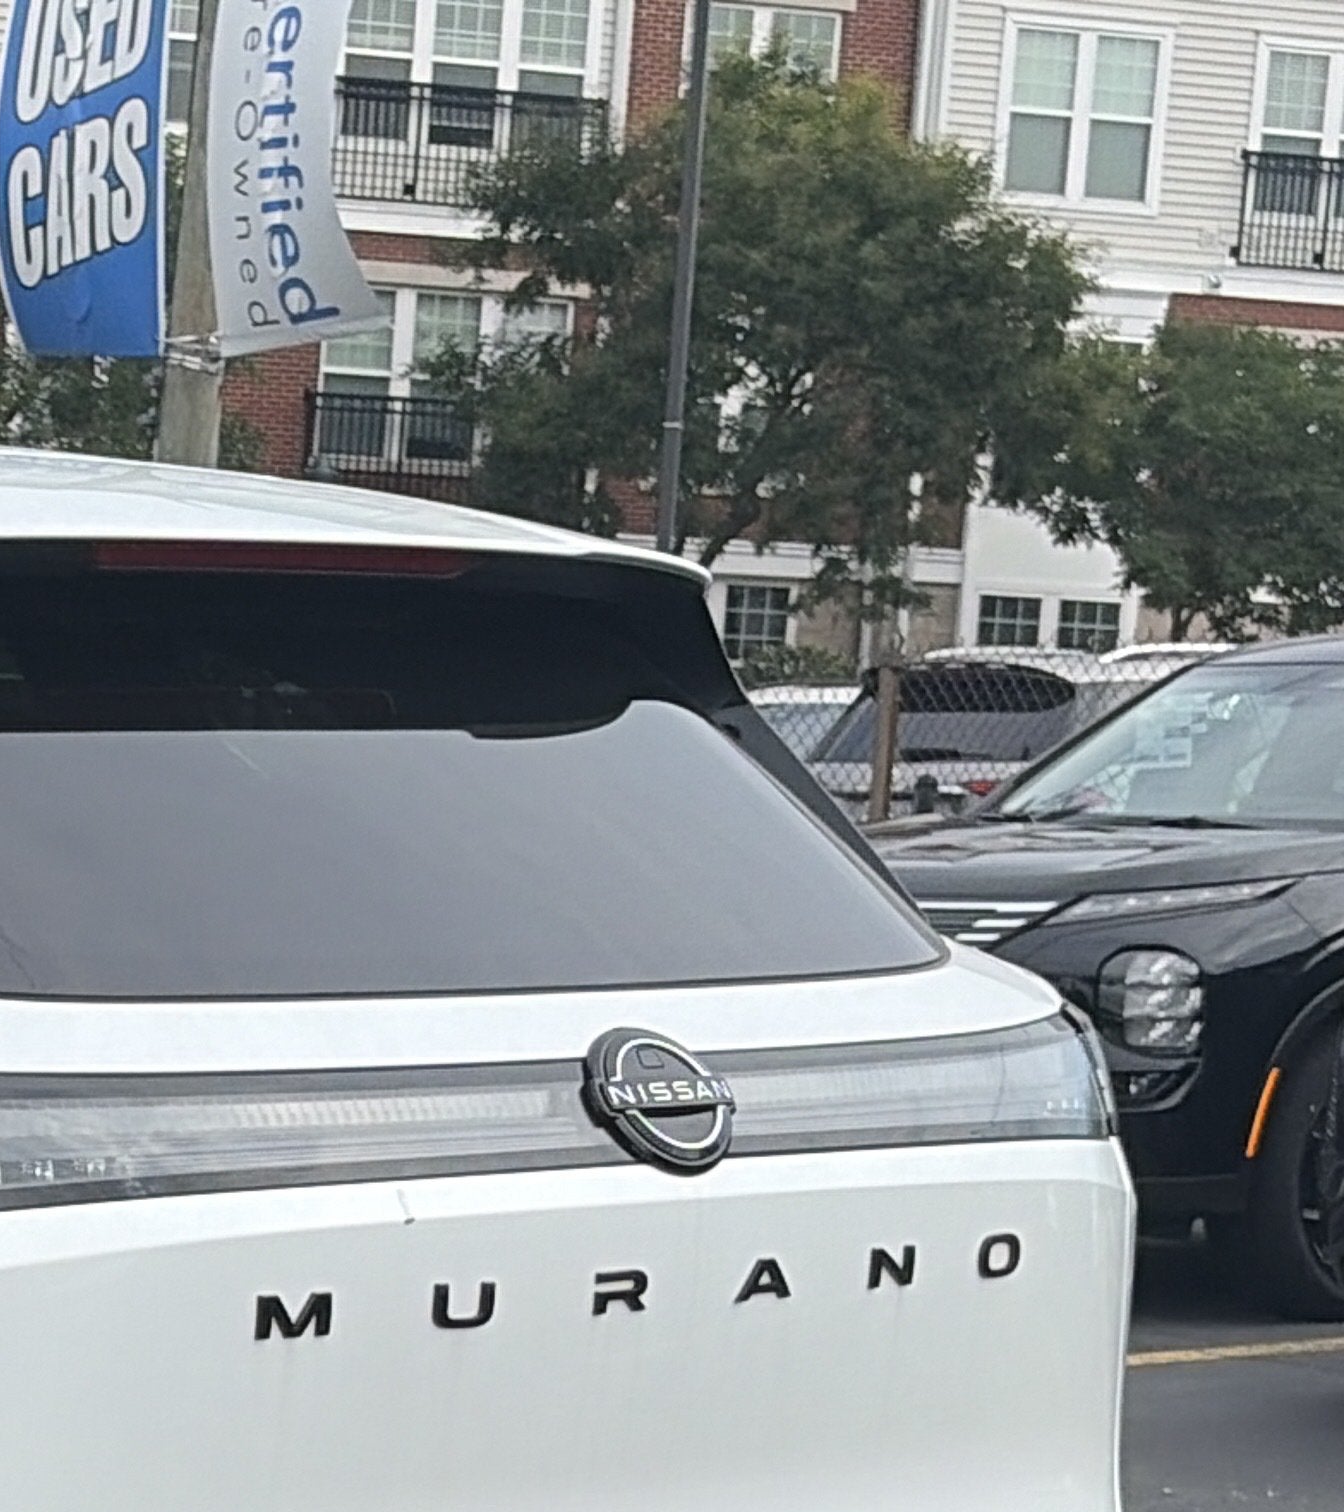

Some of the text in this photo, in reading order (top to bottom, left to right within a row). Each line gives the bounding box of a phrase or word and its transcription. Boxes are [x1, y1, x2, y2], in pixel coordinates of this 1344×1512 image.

[15, 0, 153, 122] USED
[7, 97, 149, 289] CARS
[233, 0, 281, 328] re-Owned
[258, 5, 341, 326] ertified
[607, 1080, 732, 1105] NISSAN
[254, 1233, 1021, 1341] MURANO
